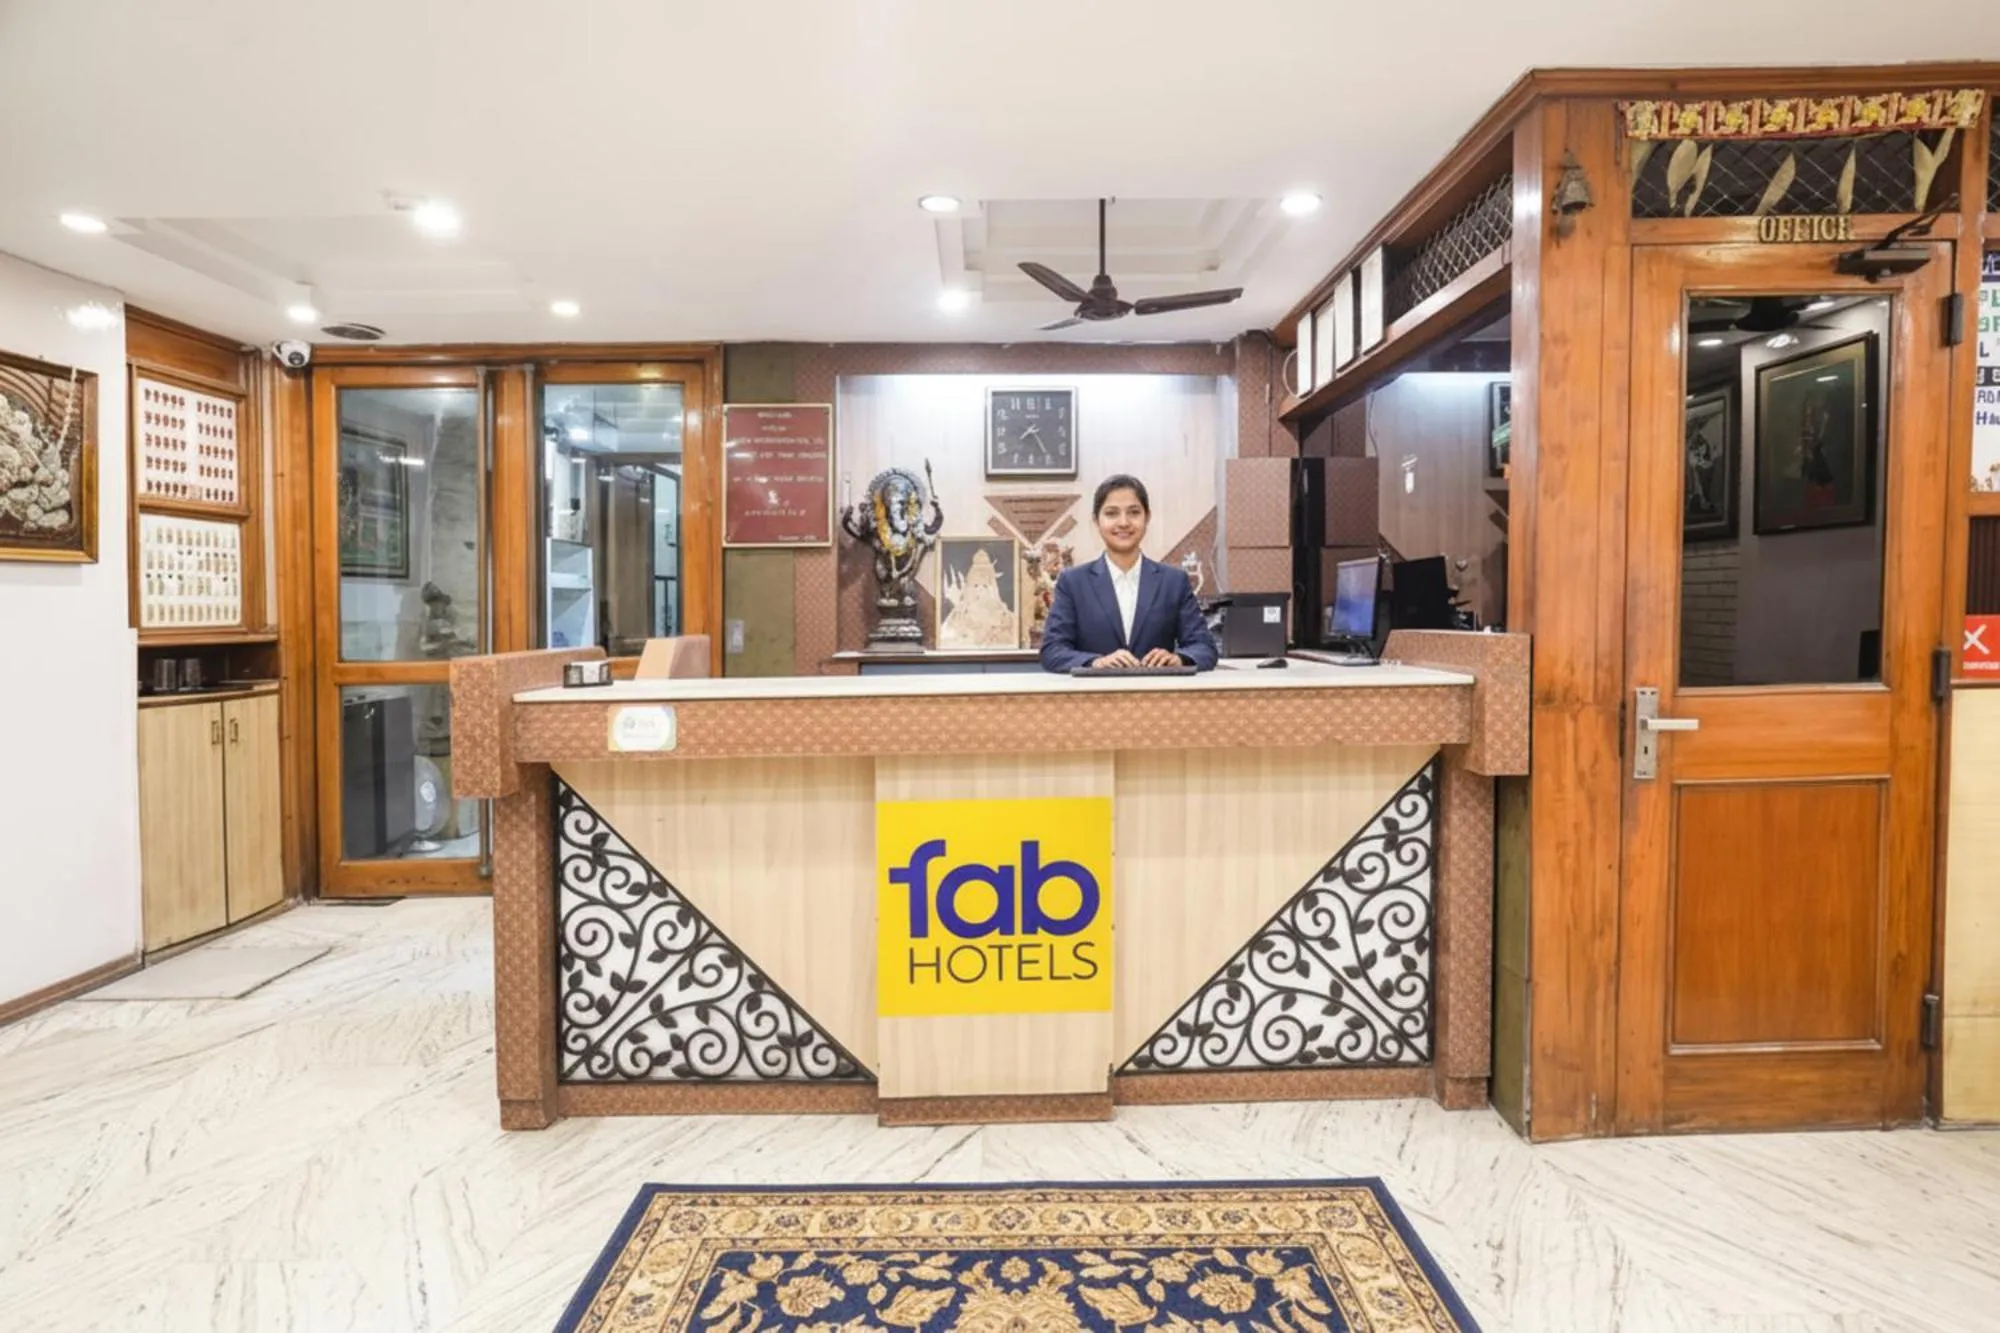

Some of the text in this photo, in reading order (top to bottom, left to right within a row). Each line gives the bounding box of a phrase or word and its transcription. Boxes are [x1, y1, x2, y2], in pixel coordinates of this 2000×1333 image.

[1760, 215, 1854, 242] OFFICE
[888, 839, 1101, 939] fab
[909, 941, 1099, 985] HOTELS
